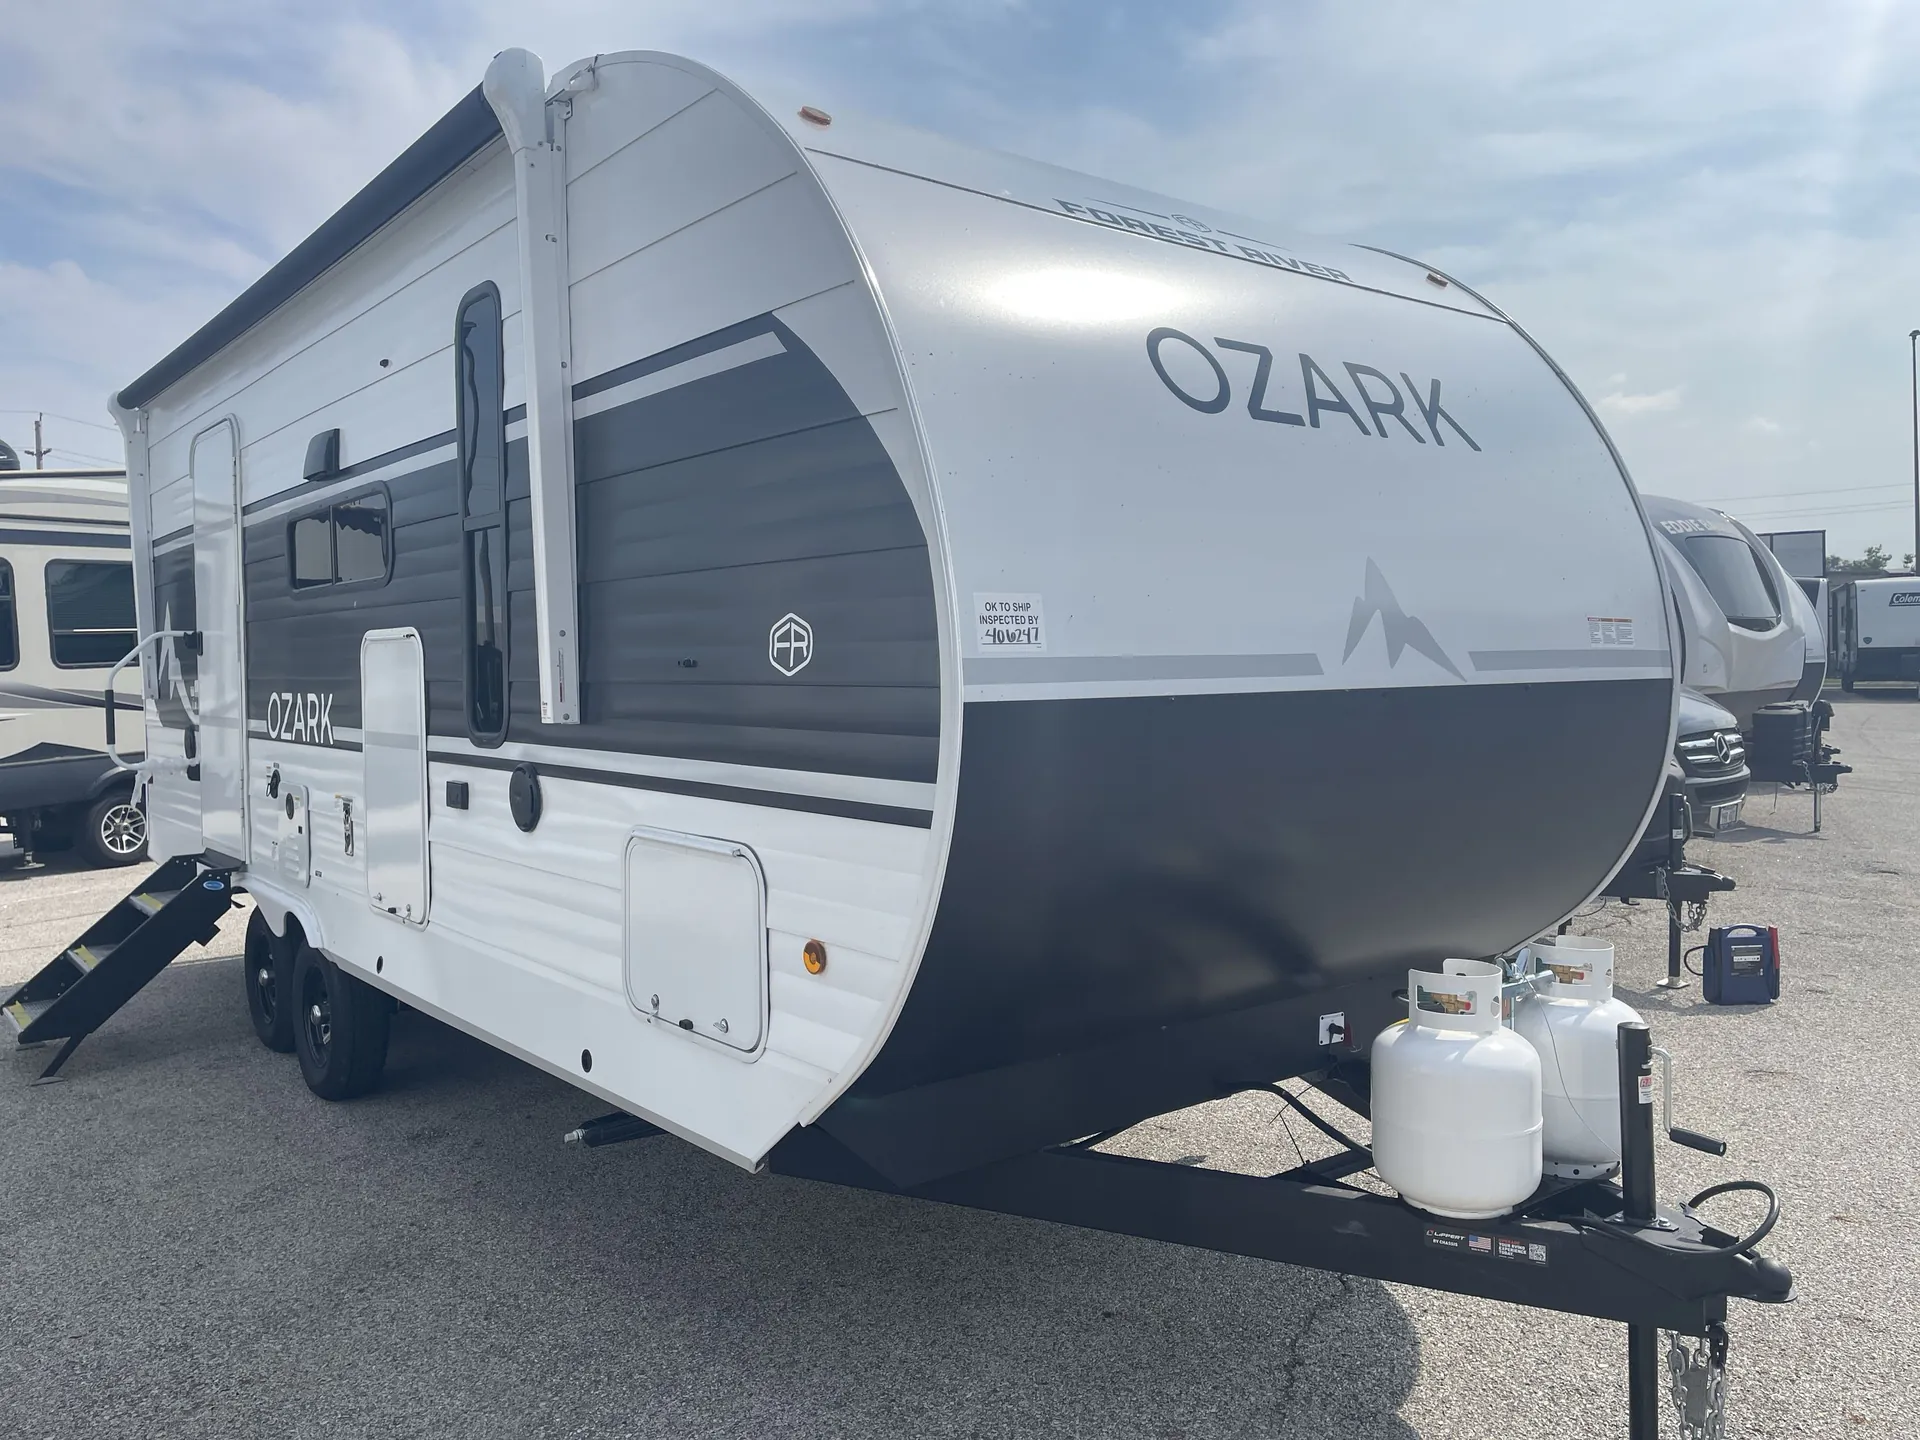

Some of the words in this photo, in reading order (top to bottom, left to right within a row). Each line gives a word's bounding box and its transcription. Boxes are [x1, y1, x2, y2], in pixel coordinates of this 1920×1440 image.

[1052, 198, 1228, 252] FOREST
[1234, 244, 1354, 283] RIVER
[1146, 327, 1482, 452] OZARK
[1660, 519, 1705, 535] EDDIE
[984, 602, 998, 612] OK
[999, 602, 1011, 612] TO
[1012, 602, 1031, 612] SHIP
[979, 615, 1026, 625] INSPECTED
[1028, 615, 1039, 625] BY
[267, 692, 334, 745] OZARK
[1434, 1231, 1466, 1240] LIPPERT
[1439, 1239, 1458, 1247] CHASSIS
